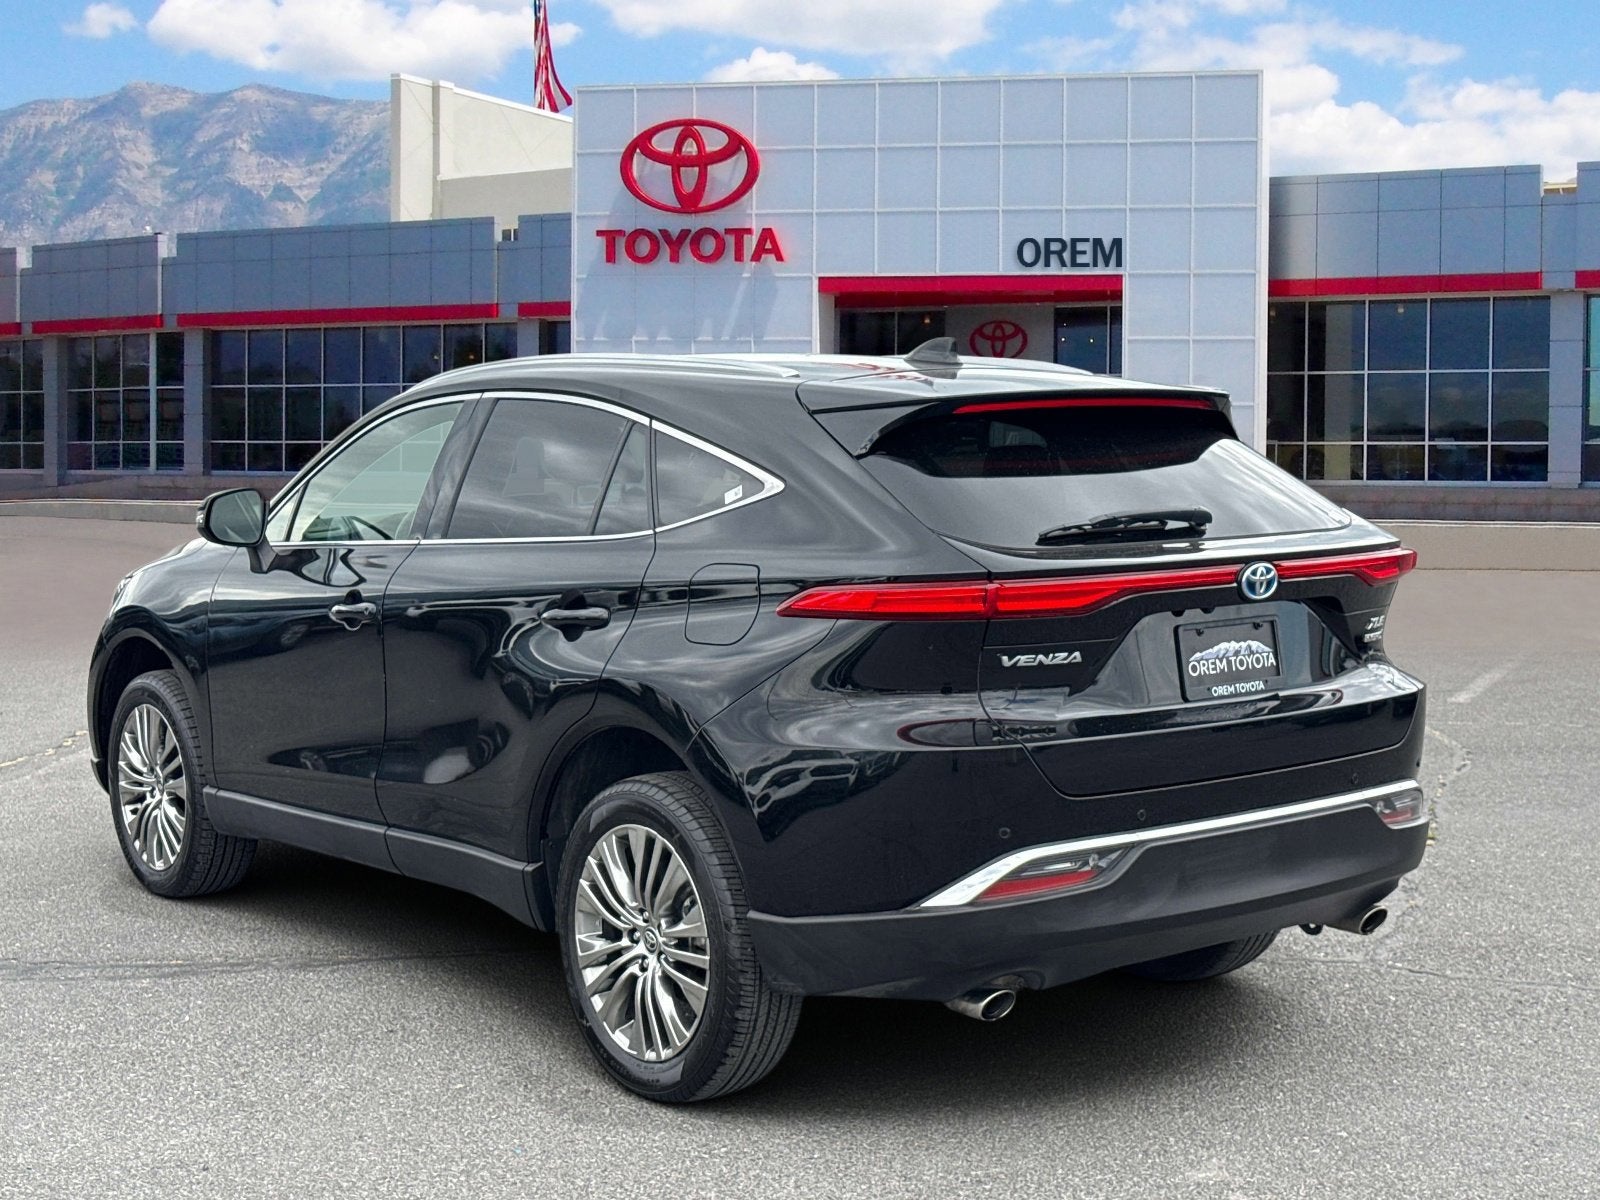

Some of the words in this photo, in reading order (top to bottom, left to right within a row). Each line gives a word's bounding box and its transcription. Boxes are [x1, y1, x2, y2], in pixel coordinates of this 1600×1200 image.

[596, 227, 785, 264] TOYOTA
[1017, 237, 1123, 268] OREM
[1000, 651, 1083, 668] VENZA
[1188, 659, 1228, 677] OREM
[1229, 652, 1277, 672] TOYOTA
[1211, 684, 1235, 697] OREM
[1235, 680, 1265, 693] TOYOTA
